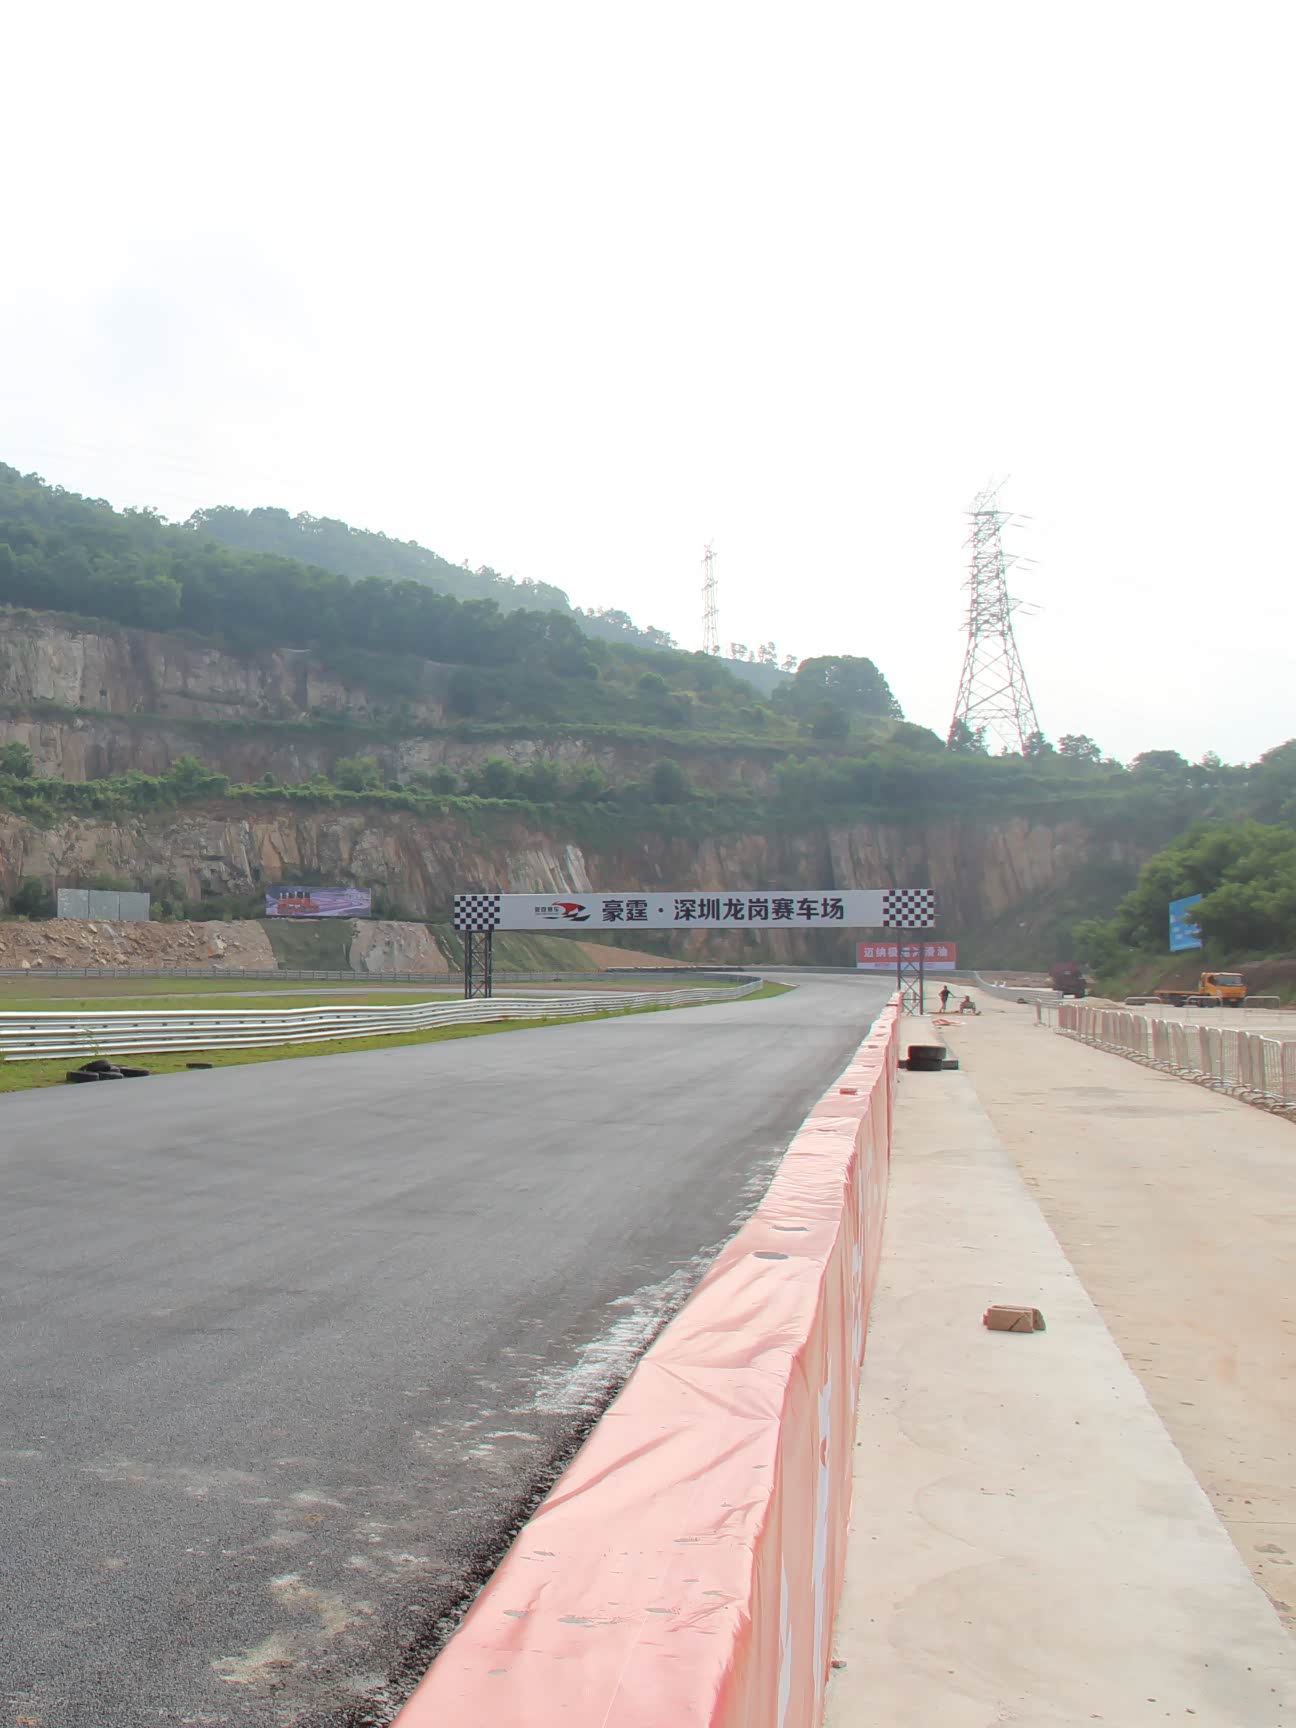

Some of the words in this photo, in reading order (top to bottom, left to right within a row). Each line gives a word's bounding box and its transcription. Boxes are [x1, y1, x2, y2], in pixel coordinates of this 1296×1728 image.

[602, 898, 844, 922] 豪霆·深圳龙岗赛车场
